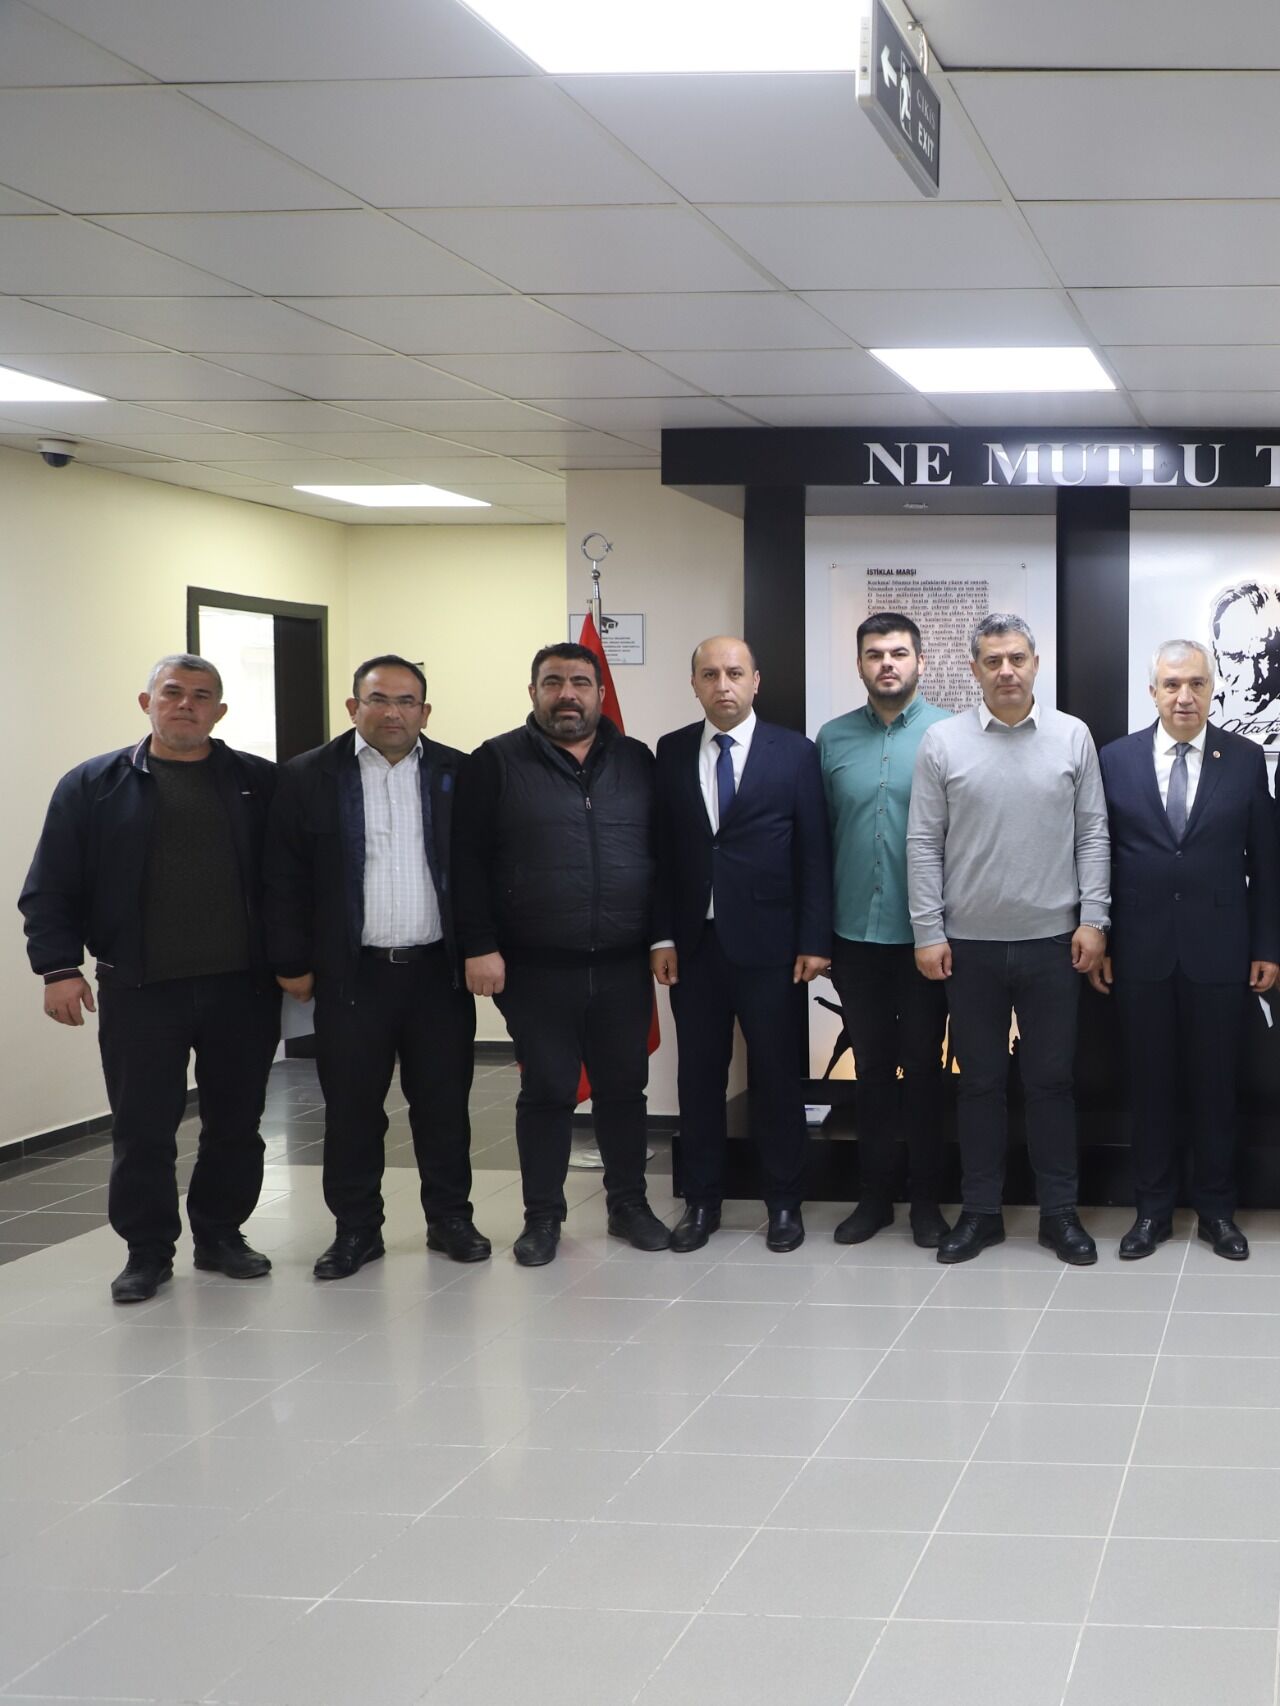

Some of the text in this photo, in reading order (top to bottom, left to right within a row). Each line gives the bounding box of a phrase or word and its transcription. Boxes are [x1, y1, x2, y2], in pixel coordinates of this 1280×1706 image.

[918, 121, 934, 162] EXIT
[863, 442, 952, 485] NE
[982, 443, 1225, 487] MUTLU
[866, 568, 894, 576] İSTİKLAL
